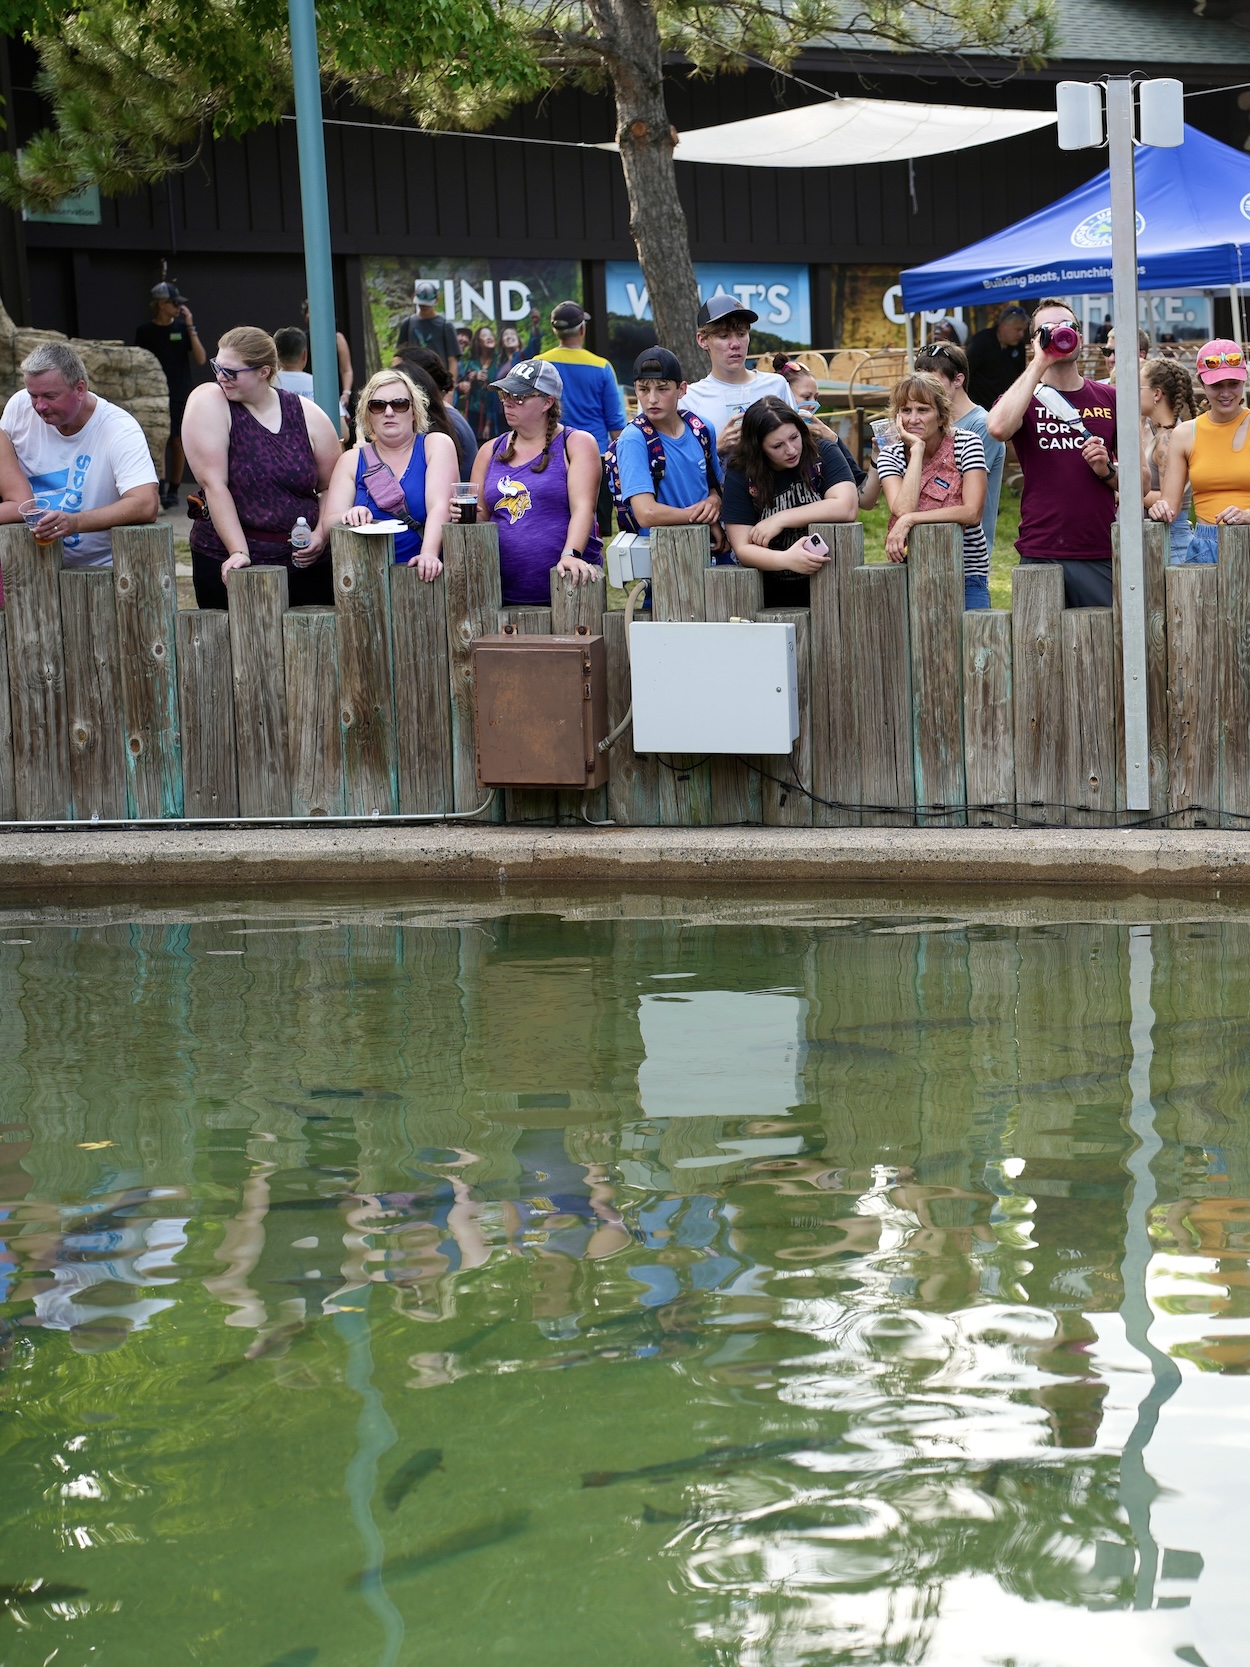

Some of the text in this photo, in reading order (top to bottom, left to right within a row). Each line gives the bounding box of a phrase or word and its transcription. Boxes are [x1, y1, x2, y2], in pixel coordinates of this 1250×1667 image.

[983, 265, 1114, 289] Building Boats, Launching
[1077, 406, 1112, 420] ARE
[1036, 422, 1072, 435] FOR
